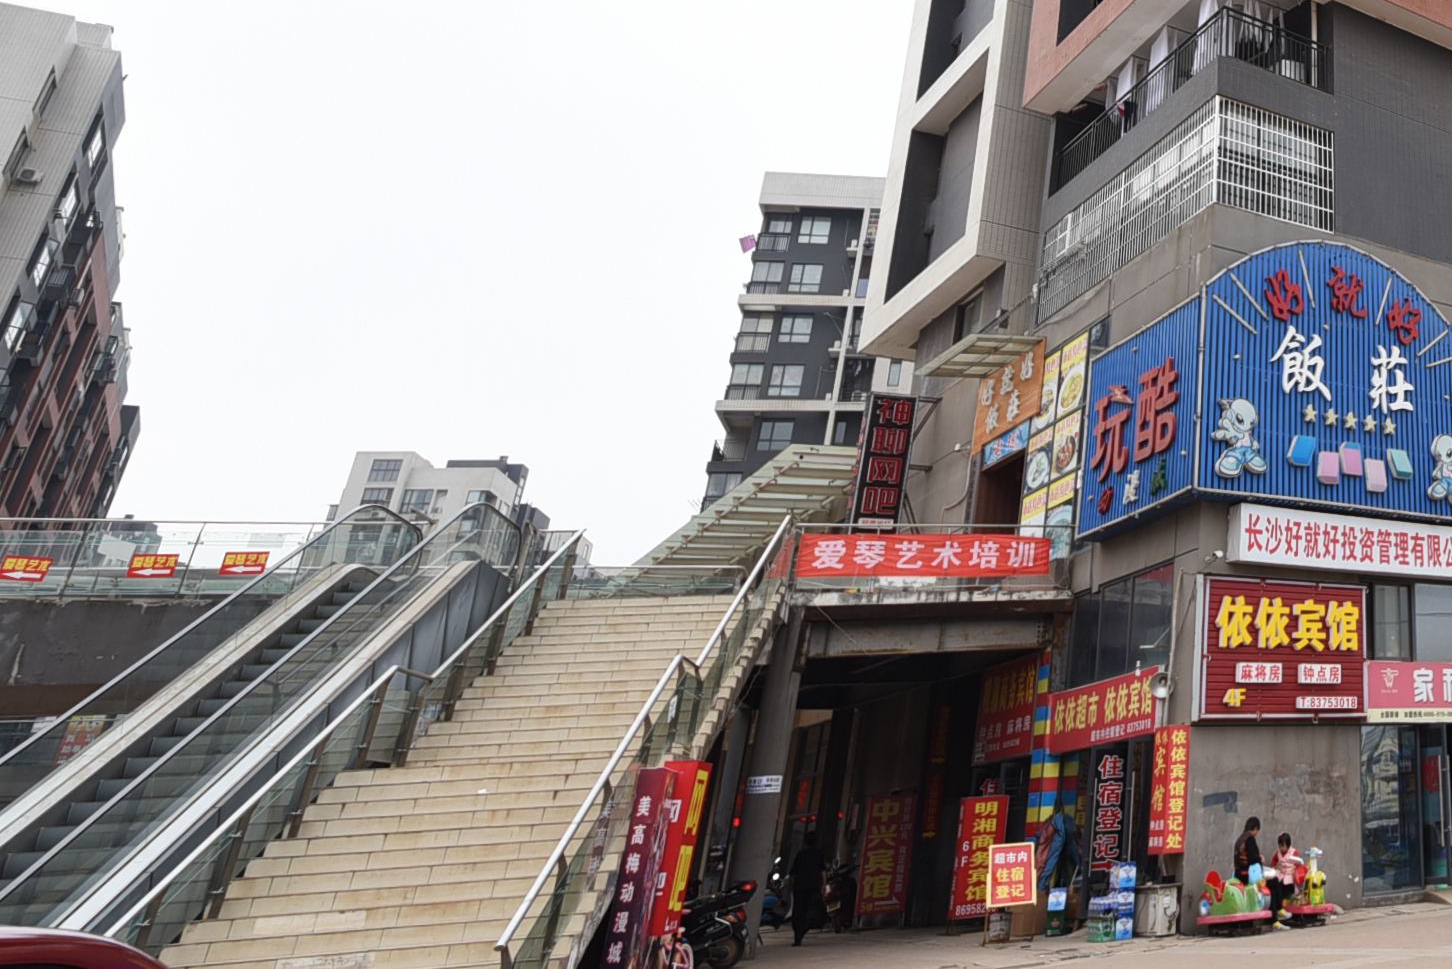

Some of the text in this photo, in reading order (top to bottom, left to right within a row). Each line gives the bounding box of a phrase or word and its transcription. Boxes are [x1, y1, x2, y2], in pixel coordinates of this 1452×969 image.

[1264, 265, 1423, 345] 好就好
[1269, 324, 1414, 414] 飯莊
[1090, 356, 1180, 483] 玩酷
[861, 398, 912, 515] 神聊网吧
[811, 539, 1036, 569] 爱琴艺术培训
[1215, 595, 1360, 652] 依依宾馆
[1054, 676, 1152, 735] 依依超市 依依宾馆
[1222, 687, 1247, 708] 4F
[1241, 664, 1340, 683] 麻将房 钟点房
[1300, 697, 1357, 709] T:83753018
[1093, 755, 1124, 857] 住宿登记
[1166, 730, 1187, 849] 依依宾馆登记处
[607, 795, 652, 964] 美高梅动漫城
[863, 799, 900, 899] 中兴宾馆
[965, 801, 998, 901] 明湘商务宾馆
[994, 851, 1027, 864] 超市内
[996, 867, 1024, 882] 住宿
[996, 884, 1025, 899] 登记
